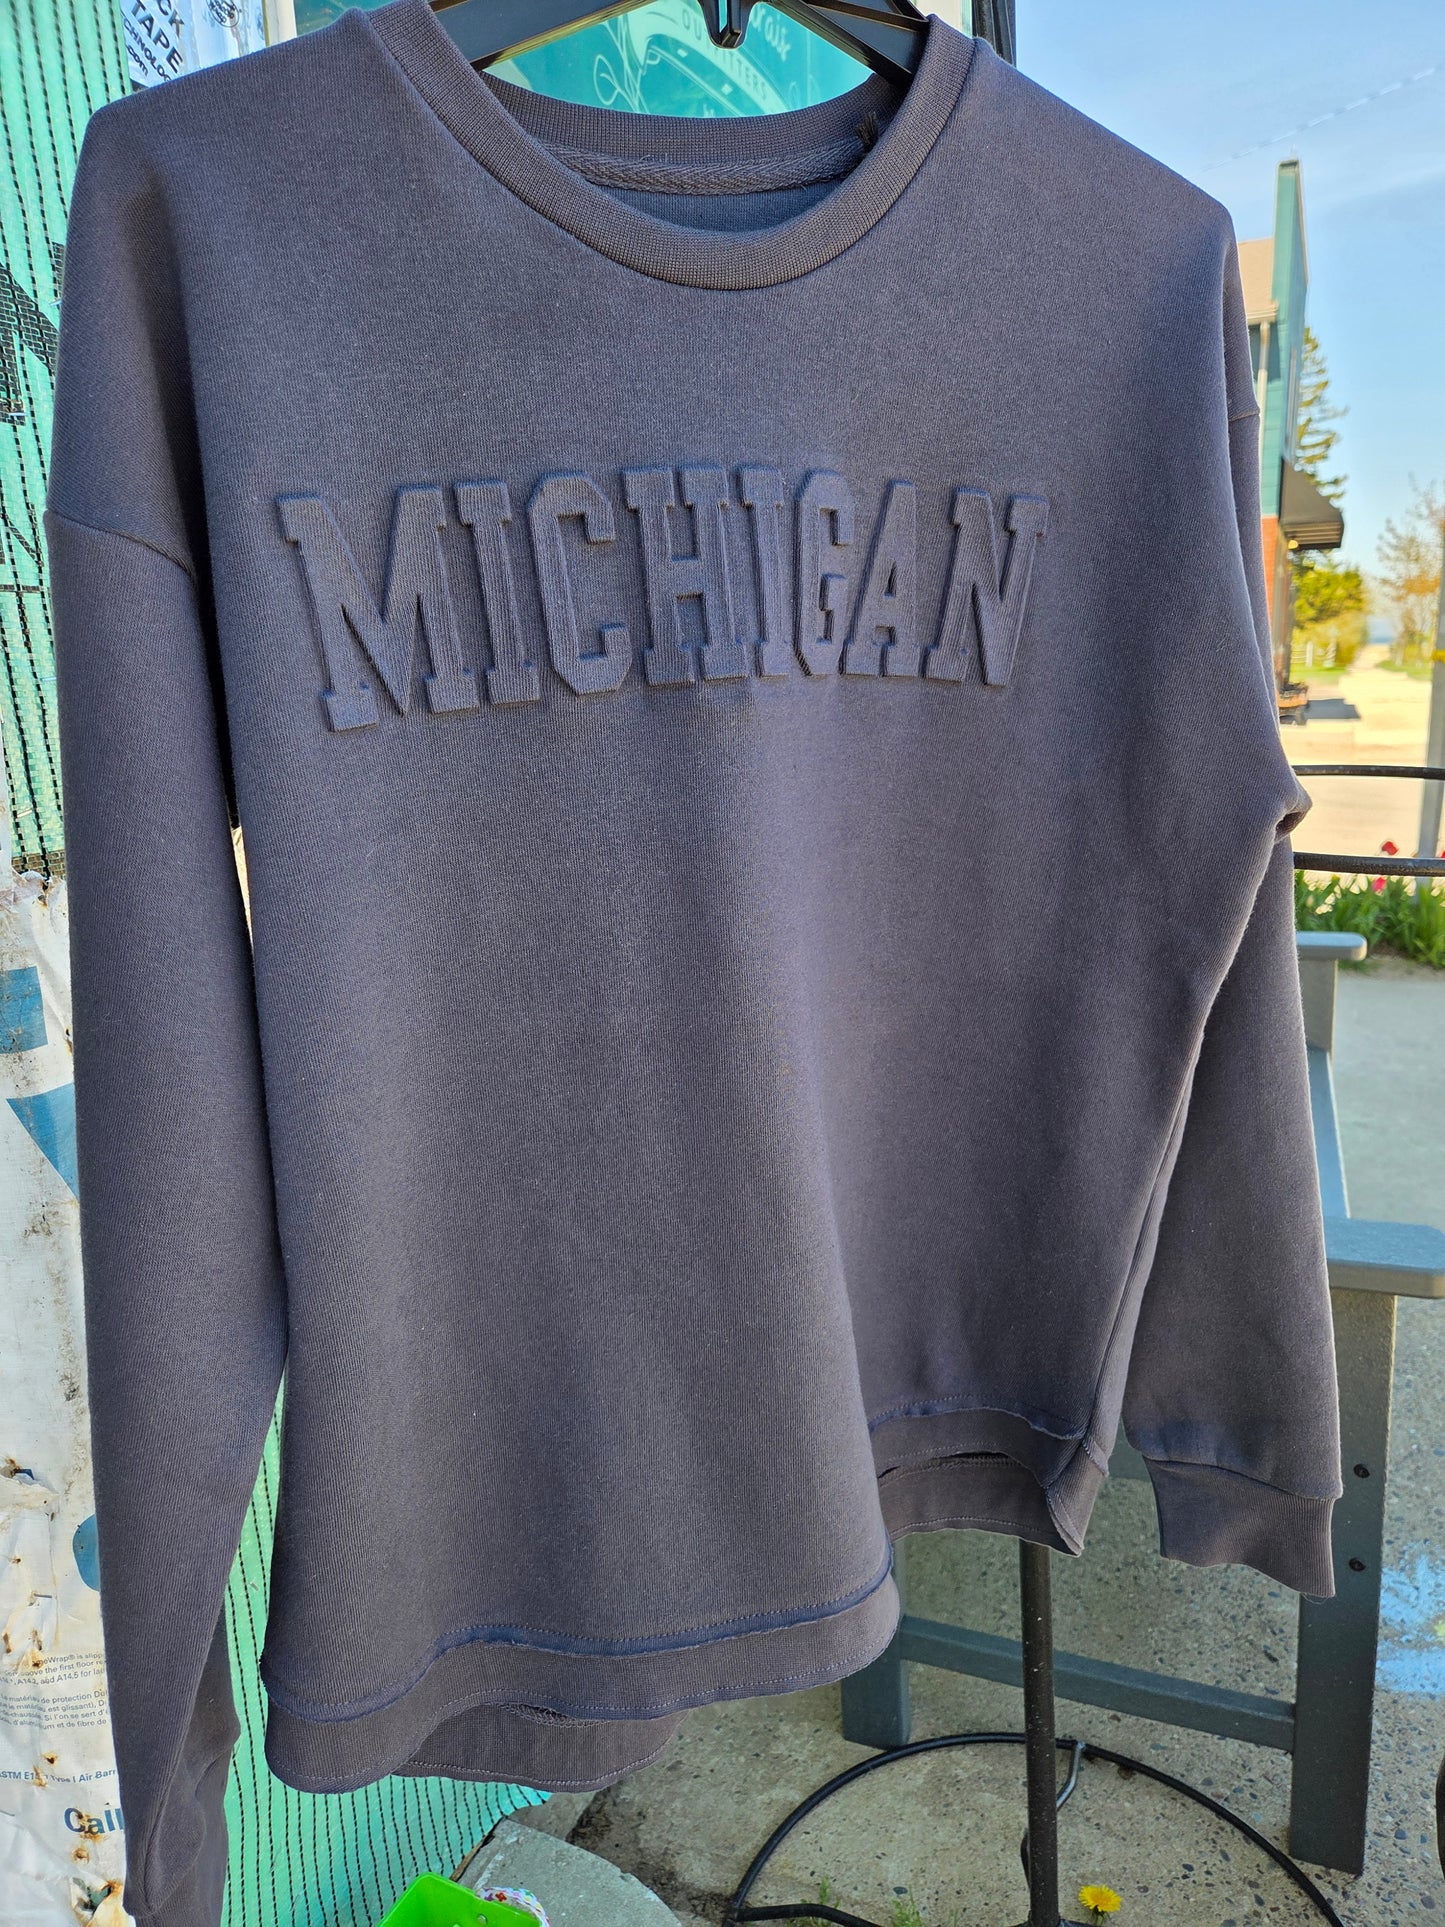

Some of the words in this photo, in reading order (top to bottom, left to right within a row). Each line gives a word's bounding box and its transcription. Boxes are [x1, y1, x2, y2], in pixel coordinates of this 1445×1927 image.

[131, 0, 184, 74] TAPE
[682, 9, 767, 100] OUITTERS
[274, 464, 1051, 733] MICHIGAN
[52, 1693, 92, 1704] protection
[77, 1719, 95, 1727] fibre
[79, 1774, 93, 1783] Air
